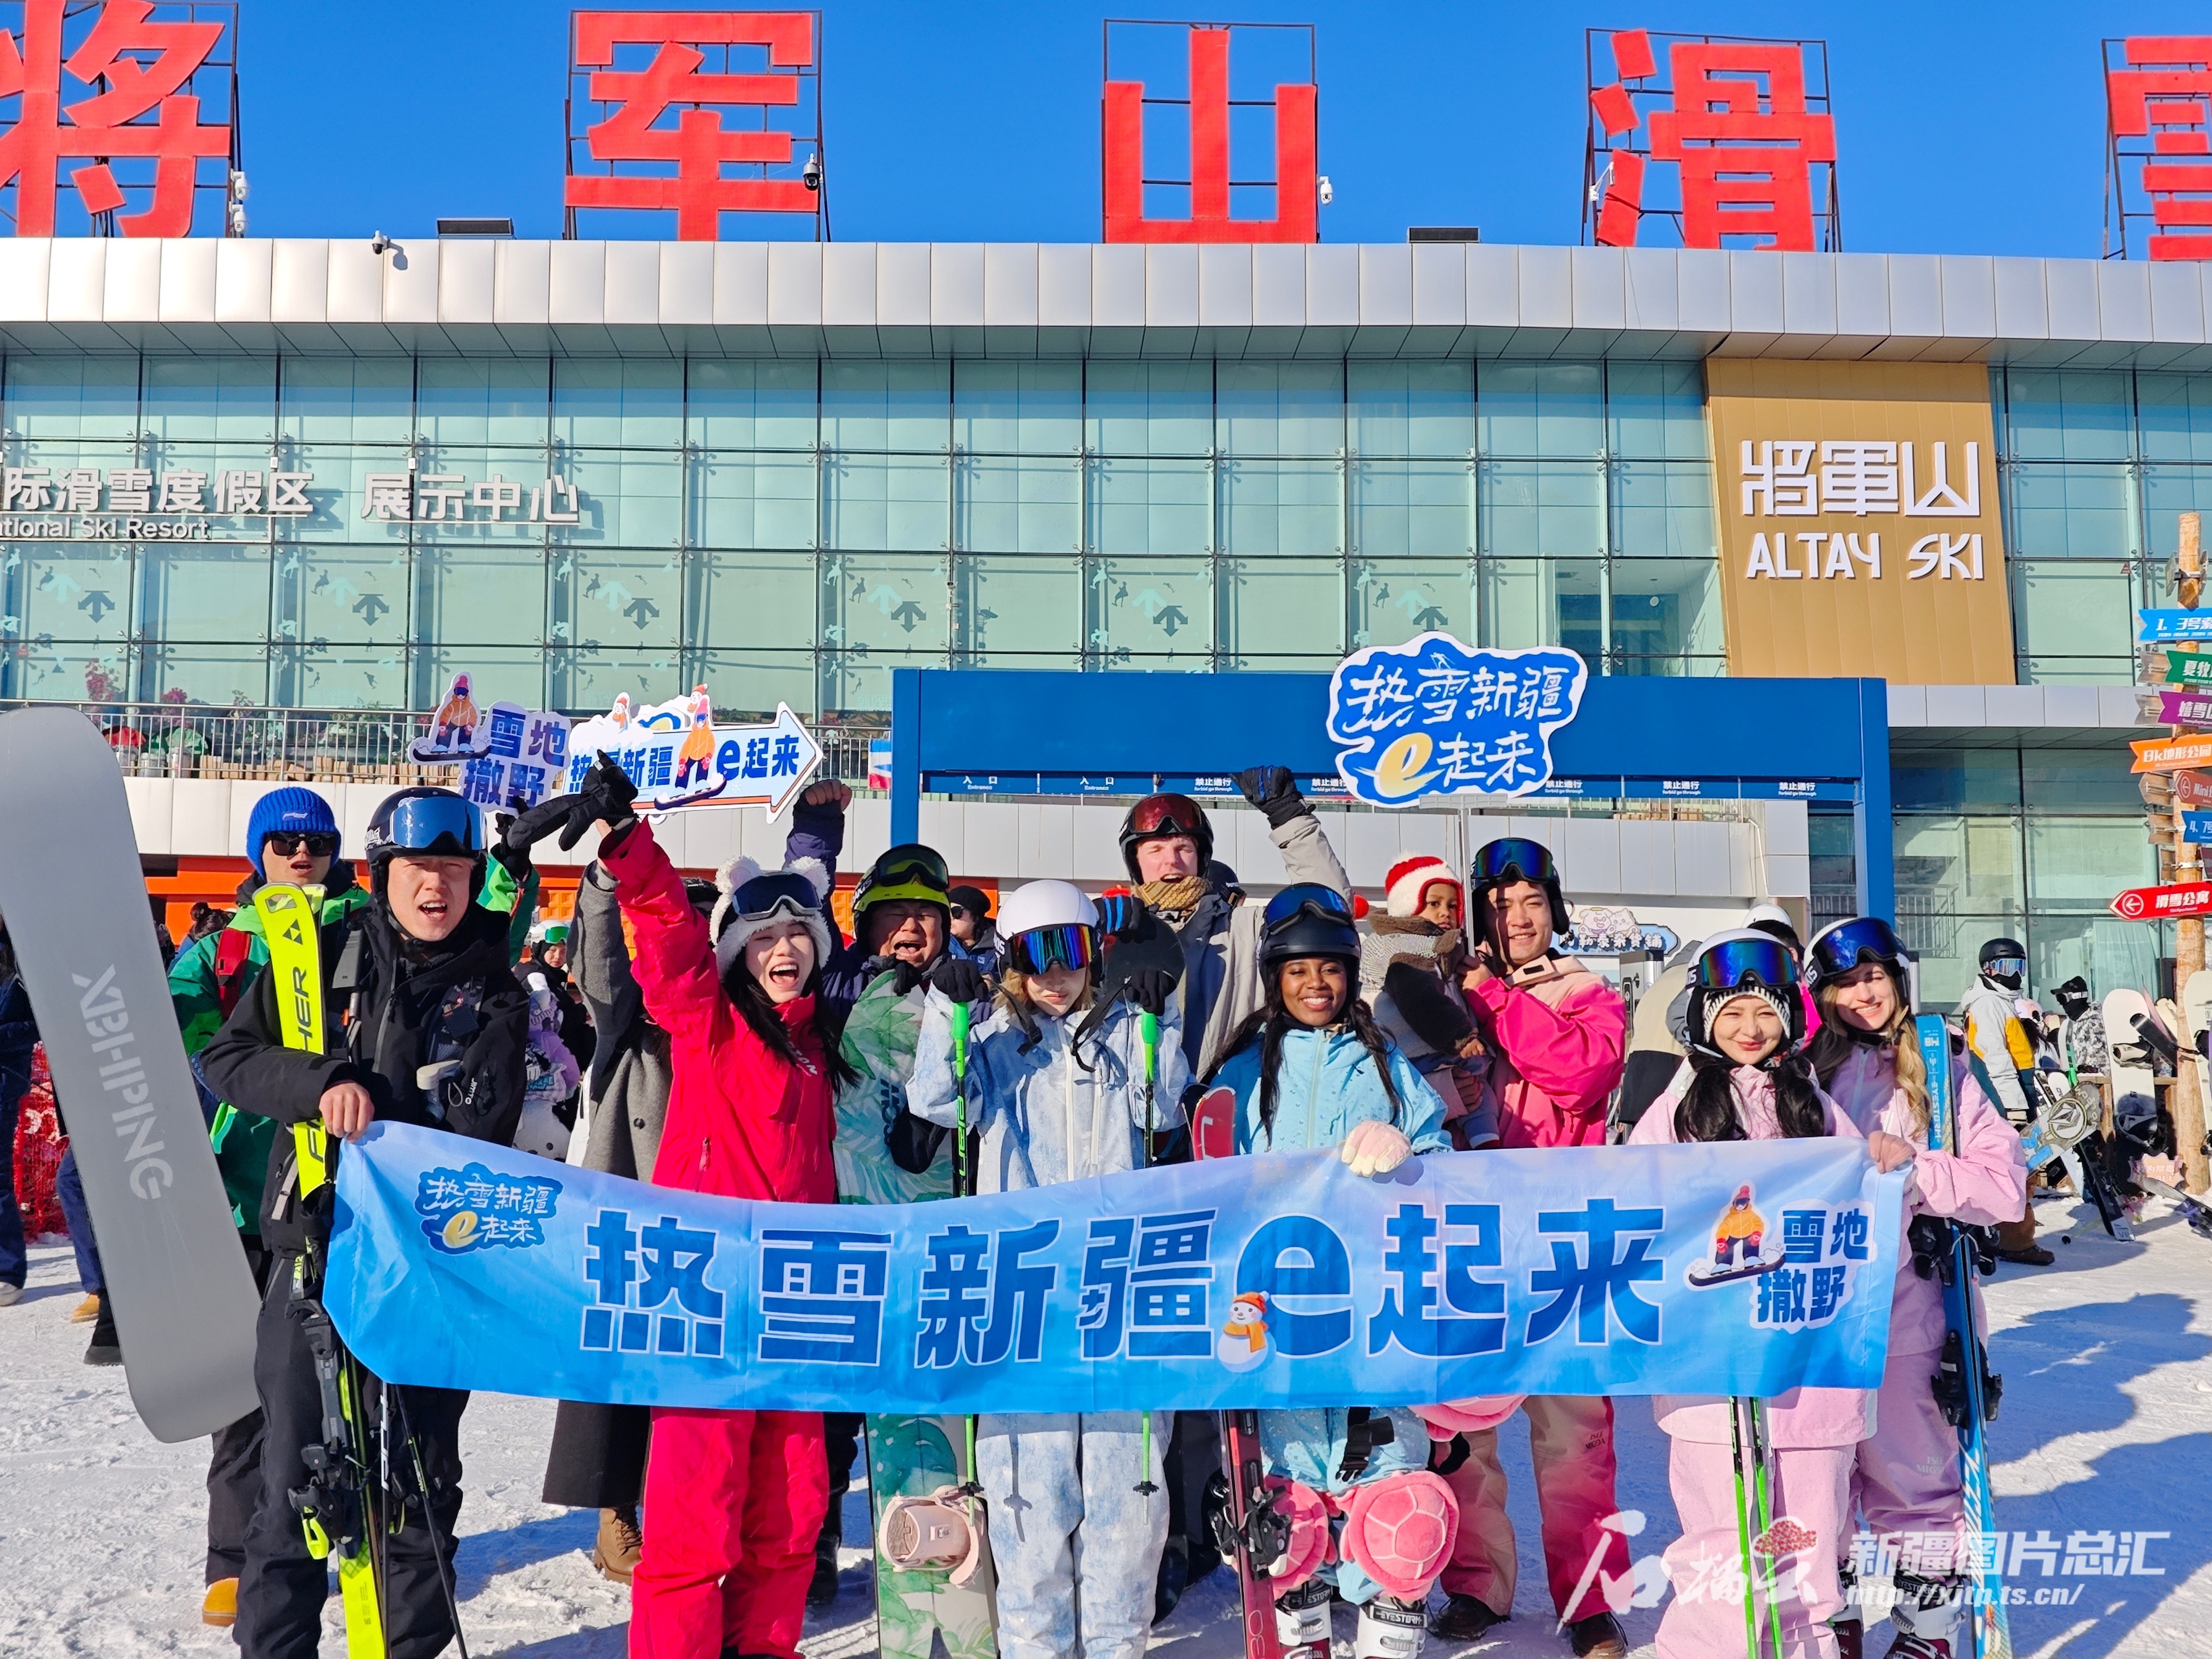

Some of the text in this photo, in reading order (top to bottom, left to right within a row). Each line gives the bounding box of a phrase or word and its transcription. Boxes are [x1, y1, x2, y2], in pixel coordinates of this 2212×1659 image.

[3, 467, 579, 522] 际滑雪度假区 展示中心
[0, 517, 209, 539] tional Ski Resort
[1746, 532, 1984, 581] ALTAY SKI
[2182, 660, 2212, 678] 夏牧
[1343, 664, 1569, 733] 热雪新疆
[490, 709, 566, 769] 雪地
[569, 736, 800, 792] 热新疆e起来
[1366, 730, 1536, 798] e起来
[463, 757, 545, 808] 撒野
[422, 1177, 555, 1216] 热雪新疆
[436, 1211, 538, 1249] e起来
[1782, 1208, 1869, 1264] 雪地
[581, 1197, 1667, 1371] 热雪新疆e起来
[1757, 1265, 1847, 1323] 撒野
